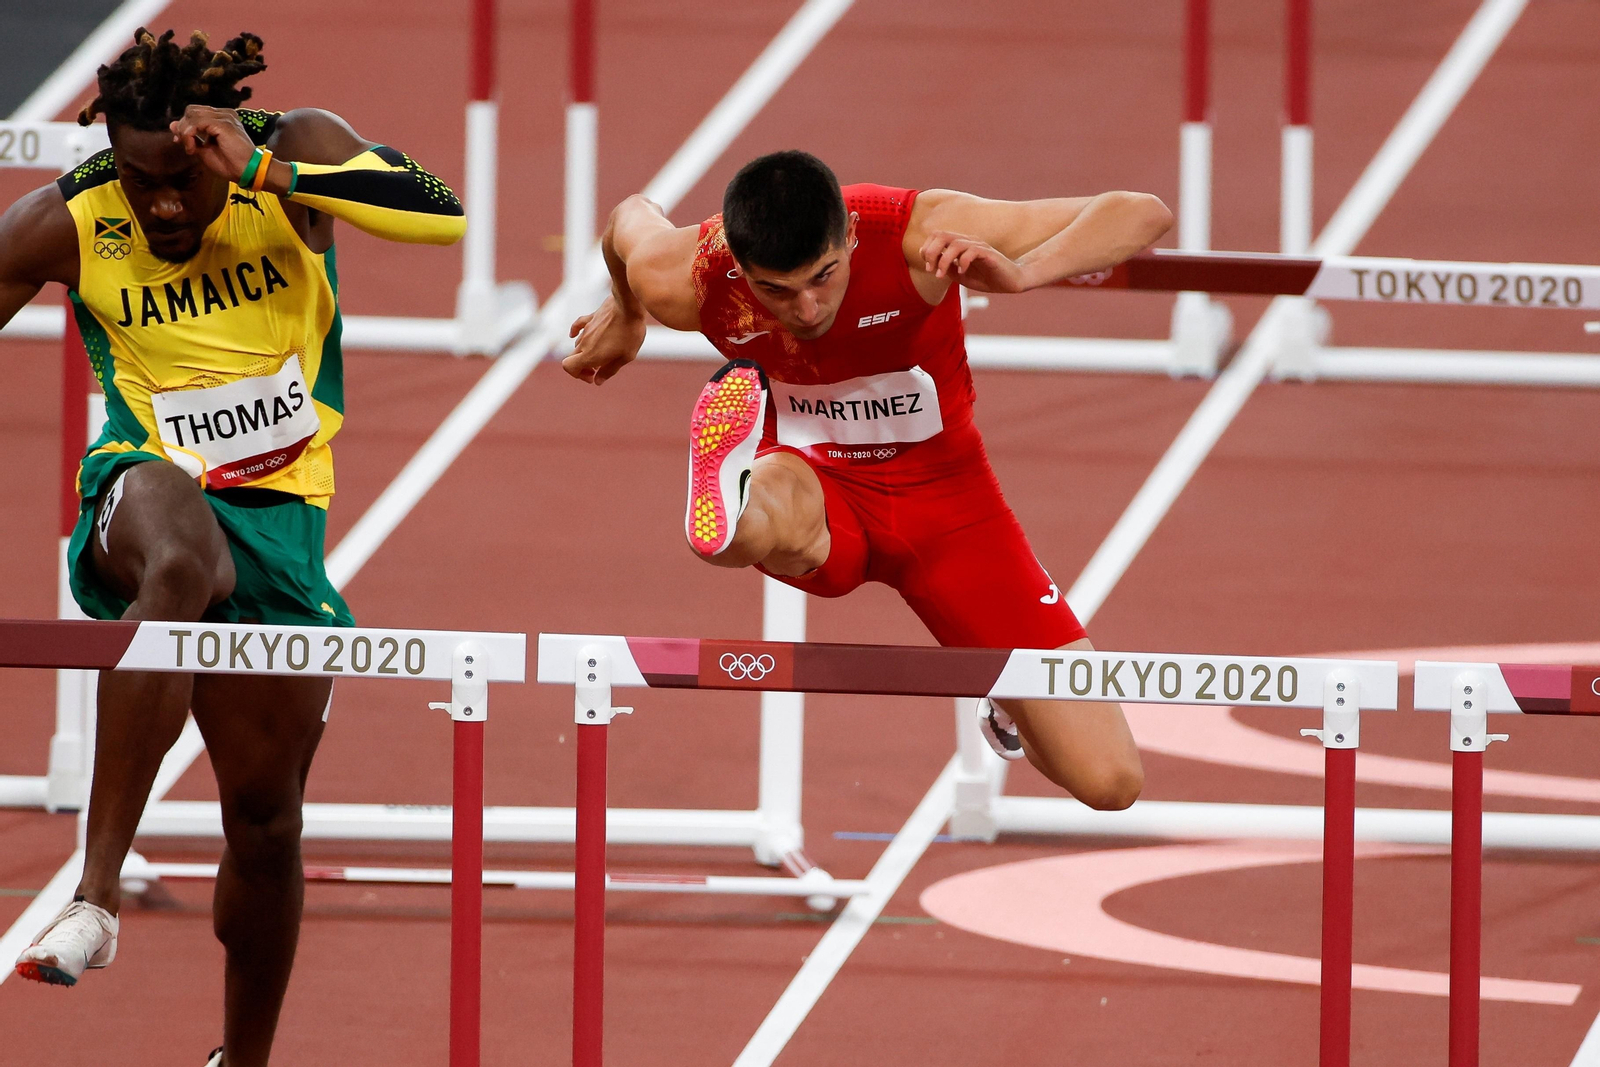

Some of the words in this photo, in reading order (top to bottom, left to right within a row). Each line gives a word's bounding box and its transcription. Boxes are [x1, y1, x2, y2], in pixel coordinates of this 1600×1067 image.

[117, 255, 289, 327] JAMAICA
[1351, 268, 1478, 302] TOKYO
[1489, 273, 1583, 305] 2020
[857, 309, 901, 328] ESP
[165, 380, 304, 447] THOMAS
[788, 392, 923, 421] MARTINEZ
[221, 469, 246, 480] TOKYO
[246, 463, 265, 474] 2020
[852, 451, 872, 459] 2020
[169, 630, 310, 671] TOKYO
[322, 634, 426, 675] 2020
[1041, 658, 1182, 699] TOKYO
[1195, 662, 1298, 702] 2020
